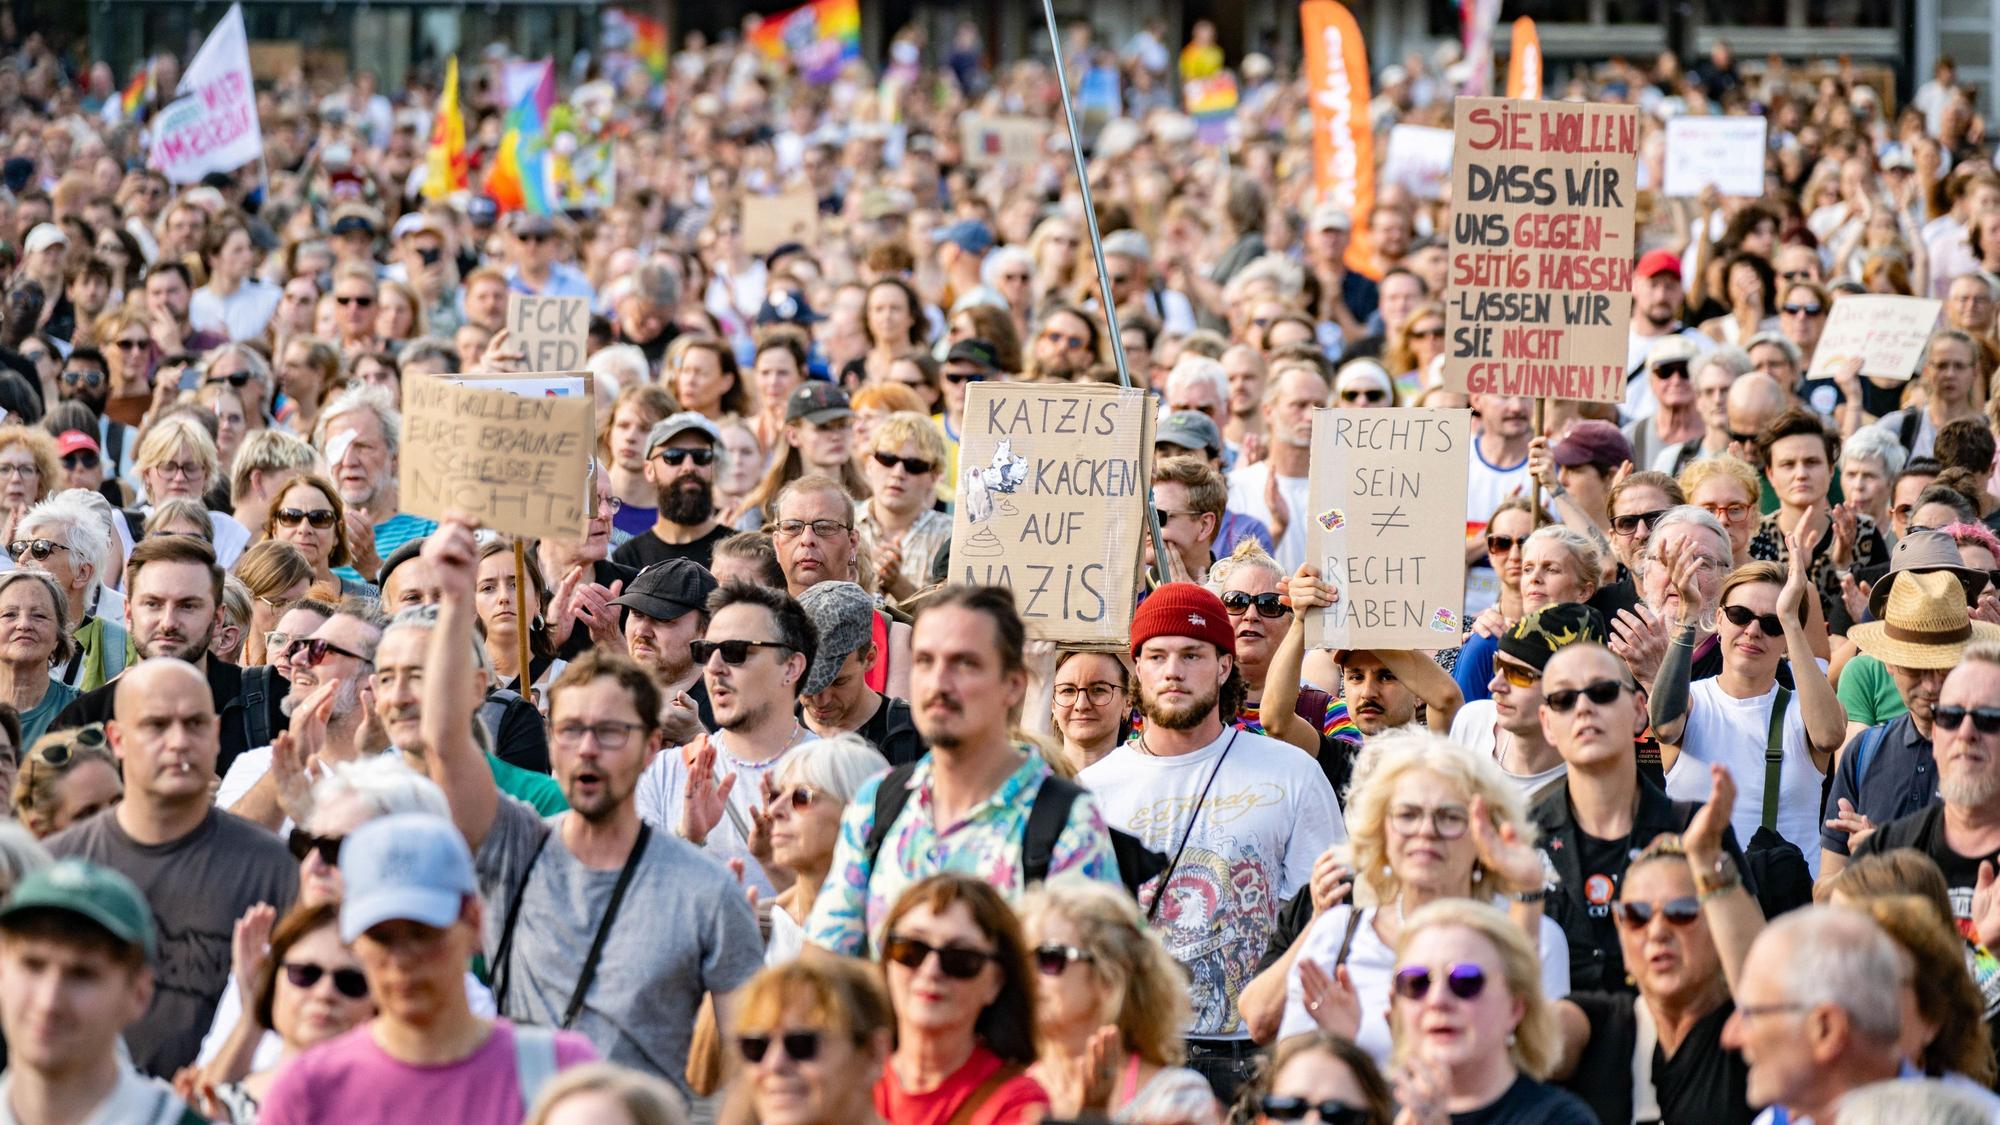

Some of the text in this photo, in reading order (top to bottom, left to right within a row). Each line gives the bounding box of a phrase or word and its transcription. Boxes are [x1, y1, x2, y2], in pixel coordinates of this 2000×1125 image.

[1468, 104, 1637, 160] SIE WOLLEN,
[1468, 159, 1624, 208] DASS WIR
[1455, 213, 1510, 247] UNS
[1453, 249, 1633, 292] SEITIG HASSEN
[517, 297, 582, 334] FCK
[1563, 291, 1612, 326] WIR
[514, 340, 580, 373] AFD
[1453, 323, 1564, 360] SIE NICHT
[1466, 359, 1595, 399] GEWINNEN
[411, 381, 450, 409] WIR
[453, 392, 555, 422] WOLLEN
[988, 397, 1119, 436] KATZIS
[407, 414, 581, 458] EURE BRAUNE
[1335, 418, 1452, 453] RECHTS
[430, 446, 559, 487] SCHEISSE
[1034, 457, 1139, 497] KACKEN
[1353, 466, 1420, 498] SEIN
[1019, 511, 1085, 547] AUF
[1326, 555, 1426, 586] RECHT
[1322, 599, 1425, 628] HABEN
